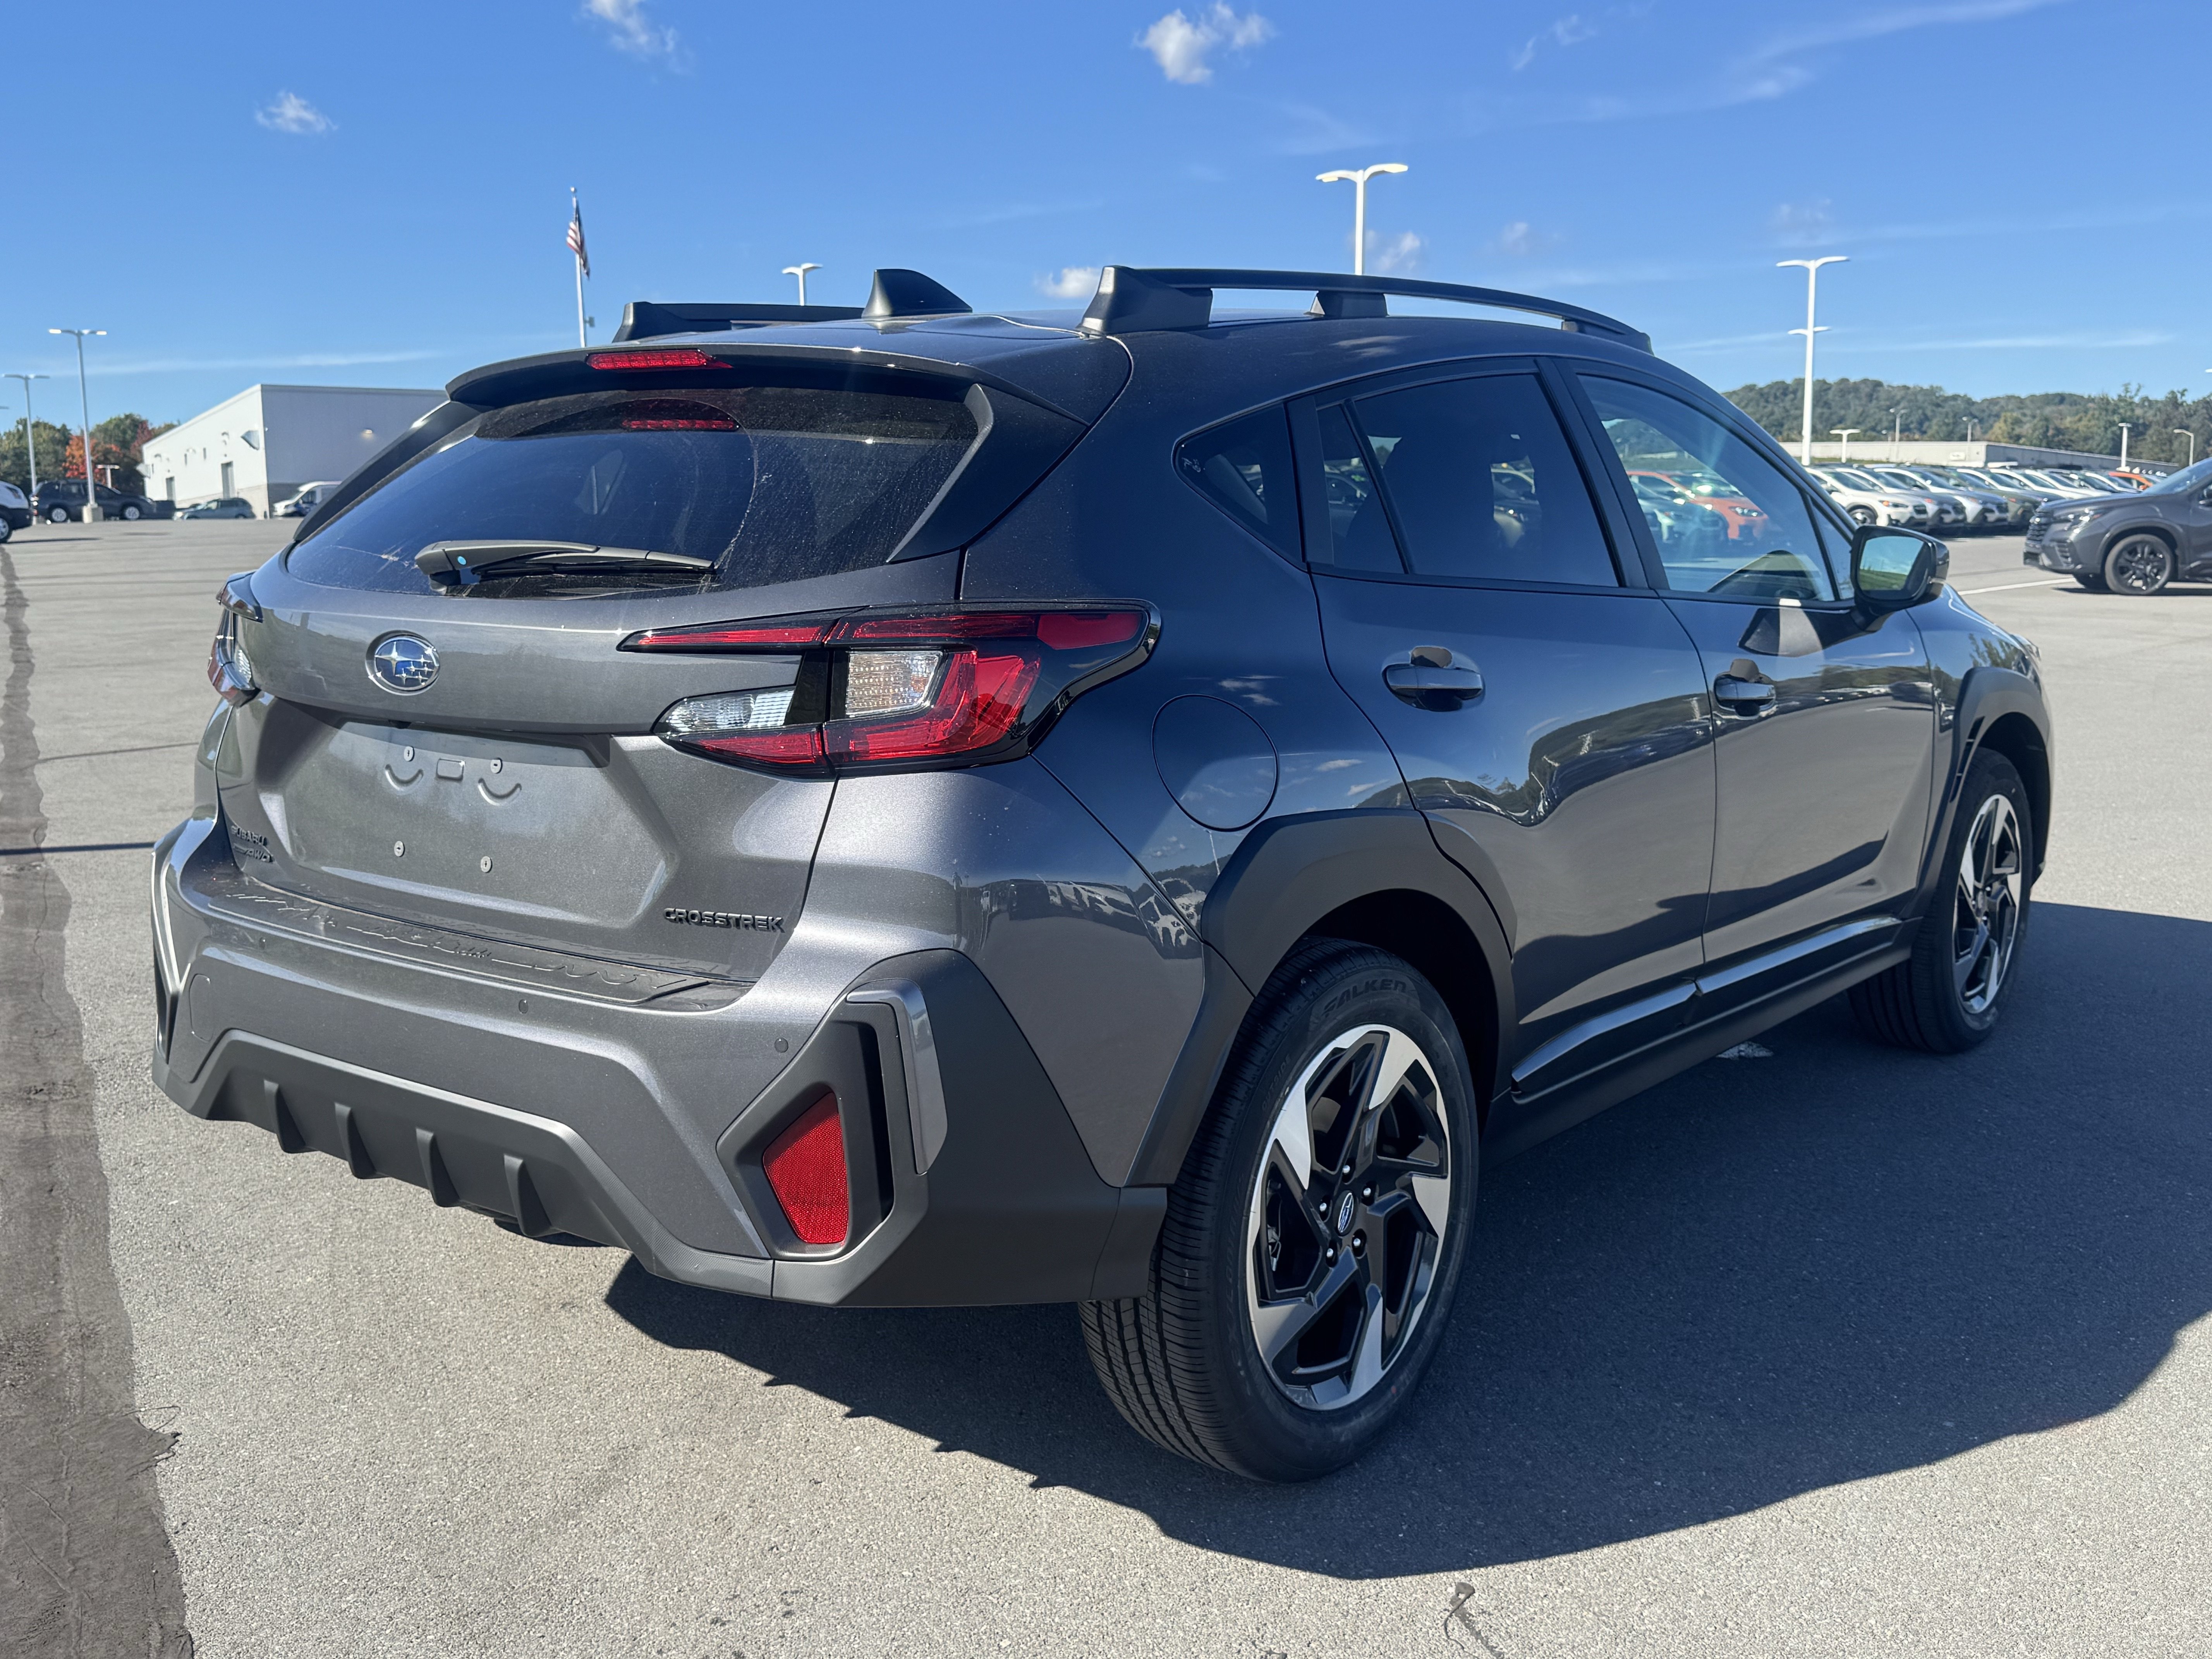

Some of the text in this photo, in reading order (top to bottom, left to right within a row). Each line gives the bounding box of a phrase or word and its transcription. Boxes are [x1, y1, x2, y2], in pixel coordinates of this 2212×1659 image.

[231, 825, 268, 847] SUBARU
[246, 848, 273, 863] AWD
[663, 907, 785, 933] CROSSTREK
[1321, 979, 1407, 1018] FALKEN
[1262, 1053, 1291, 1111] OUTSIDE
